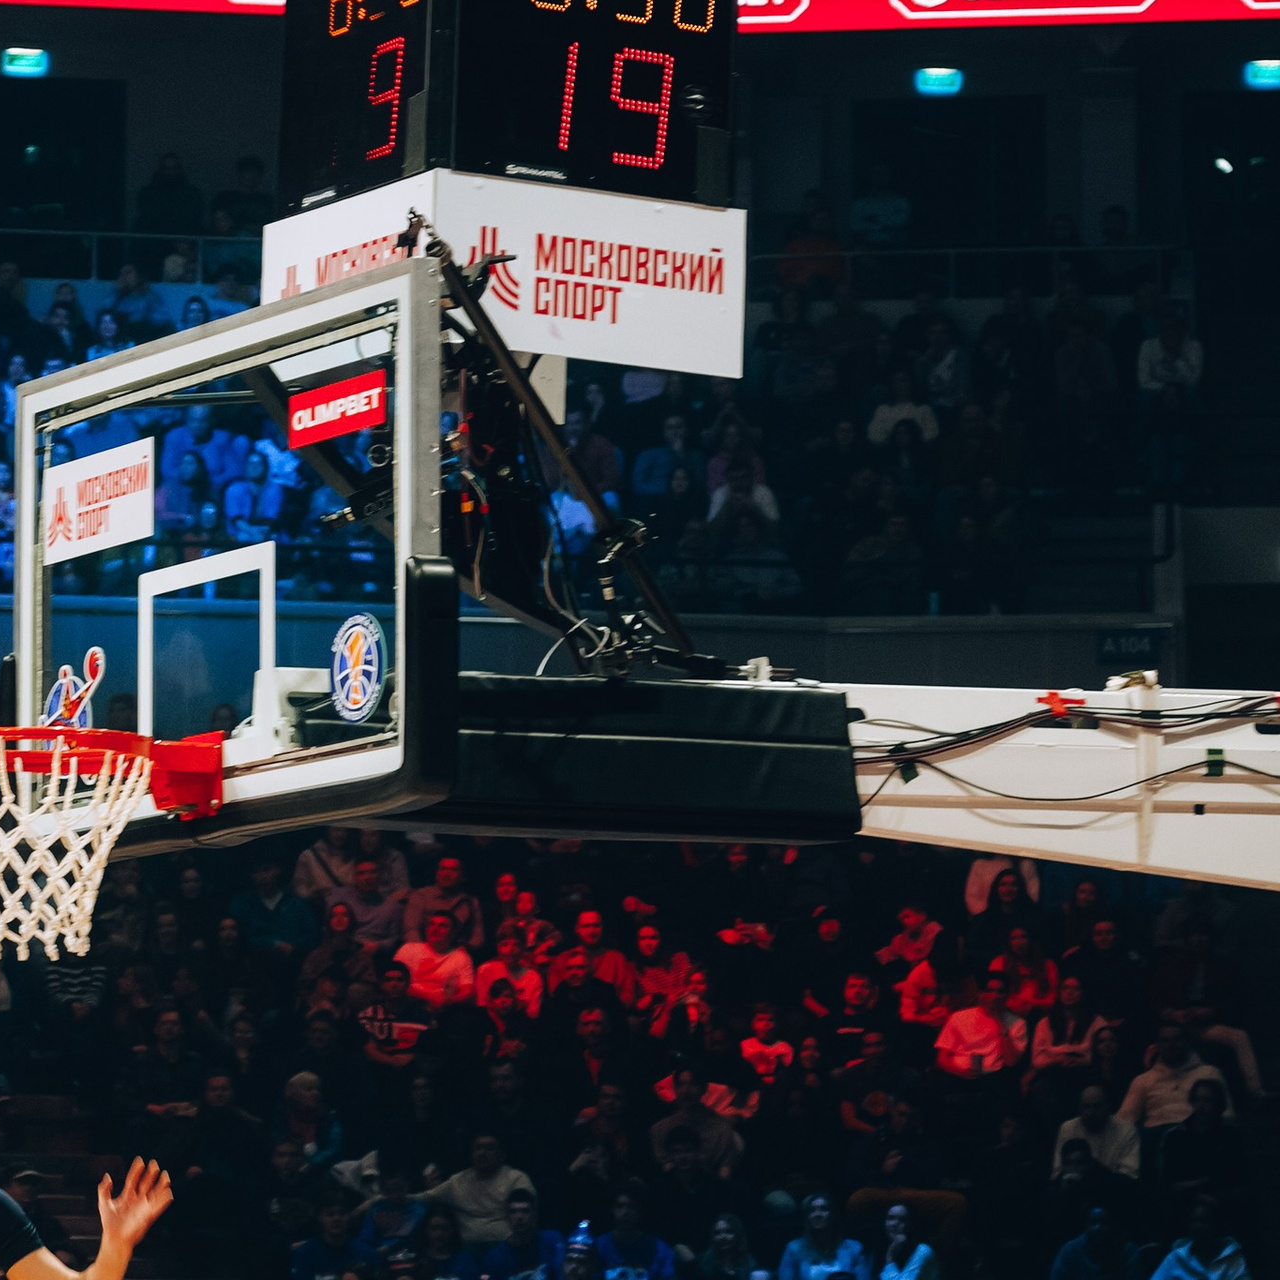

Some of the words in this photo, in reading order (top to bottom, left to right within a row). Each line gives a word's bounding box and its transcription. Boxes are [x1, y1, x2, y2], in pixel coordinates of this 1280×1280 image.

[558, 42, 675, 170] 19
[534, 232, 726, 295] МОСКОВСКИЙ
[533, 276, 623, 325] СПОРТ
[291, 387, 383, 431] OLIMPBET
[76, 454, 149, 509] МОСКОВСКИЙ
[76, 504, 111, 540] СПОРТ
